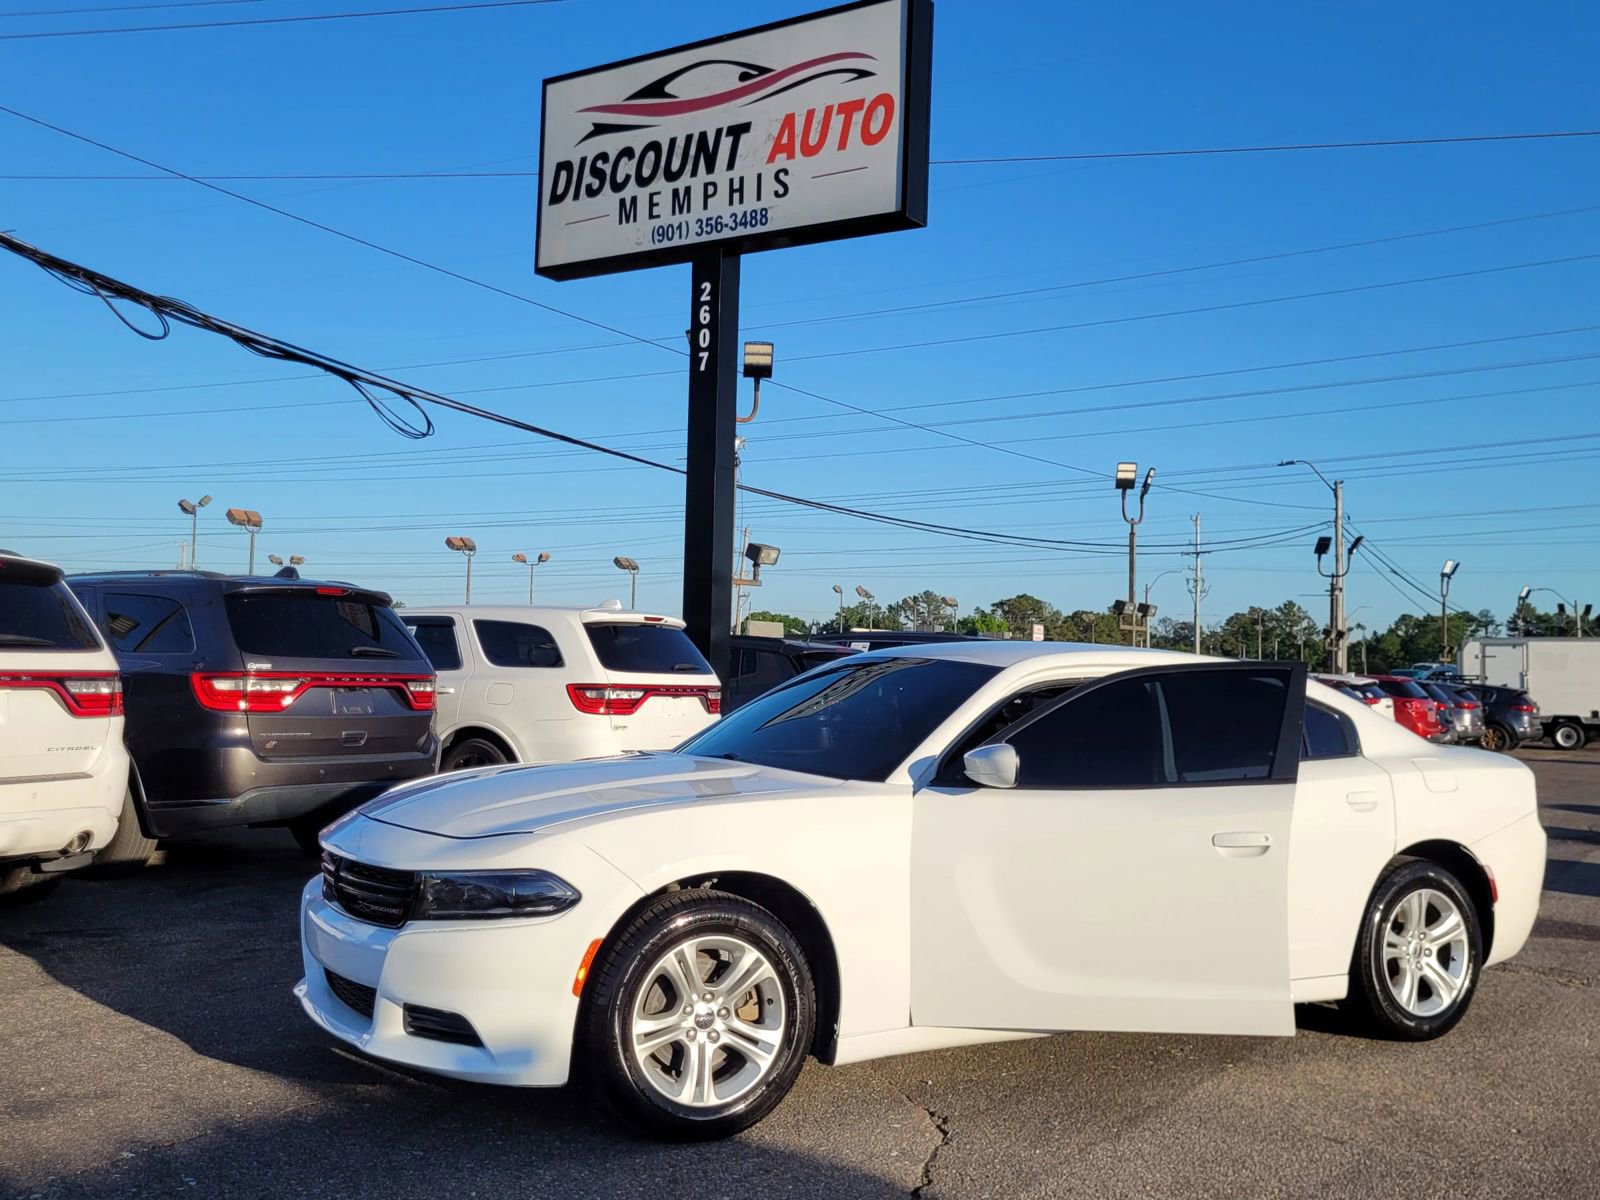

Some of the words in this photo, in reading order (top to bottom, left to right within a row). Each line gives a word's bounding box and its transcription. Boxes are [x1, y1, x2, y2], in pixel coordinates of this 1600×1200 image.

[548, 121, 753, 206] DISCOUNT
[765, 92, 895, 165] AUTO
[618, 167, 790, 225] MEMPHIS
[651, 220, 690, 245] (901)
[695, 207, 769, 237] 356-3488
[699, 281, 711, 371] 2607
